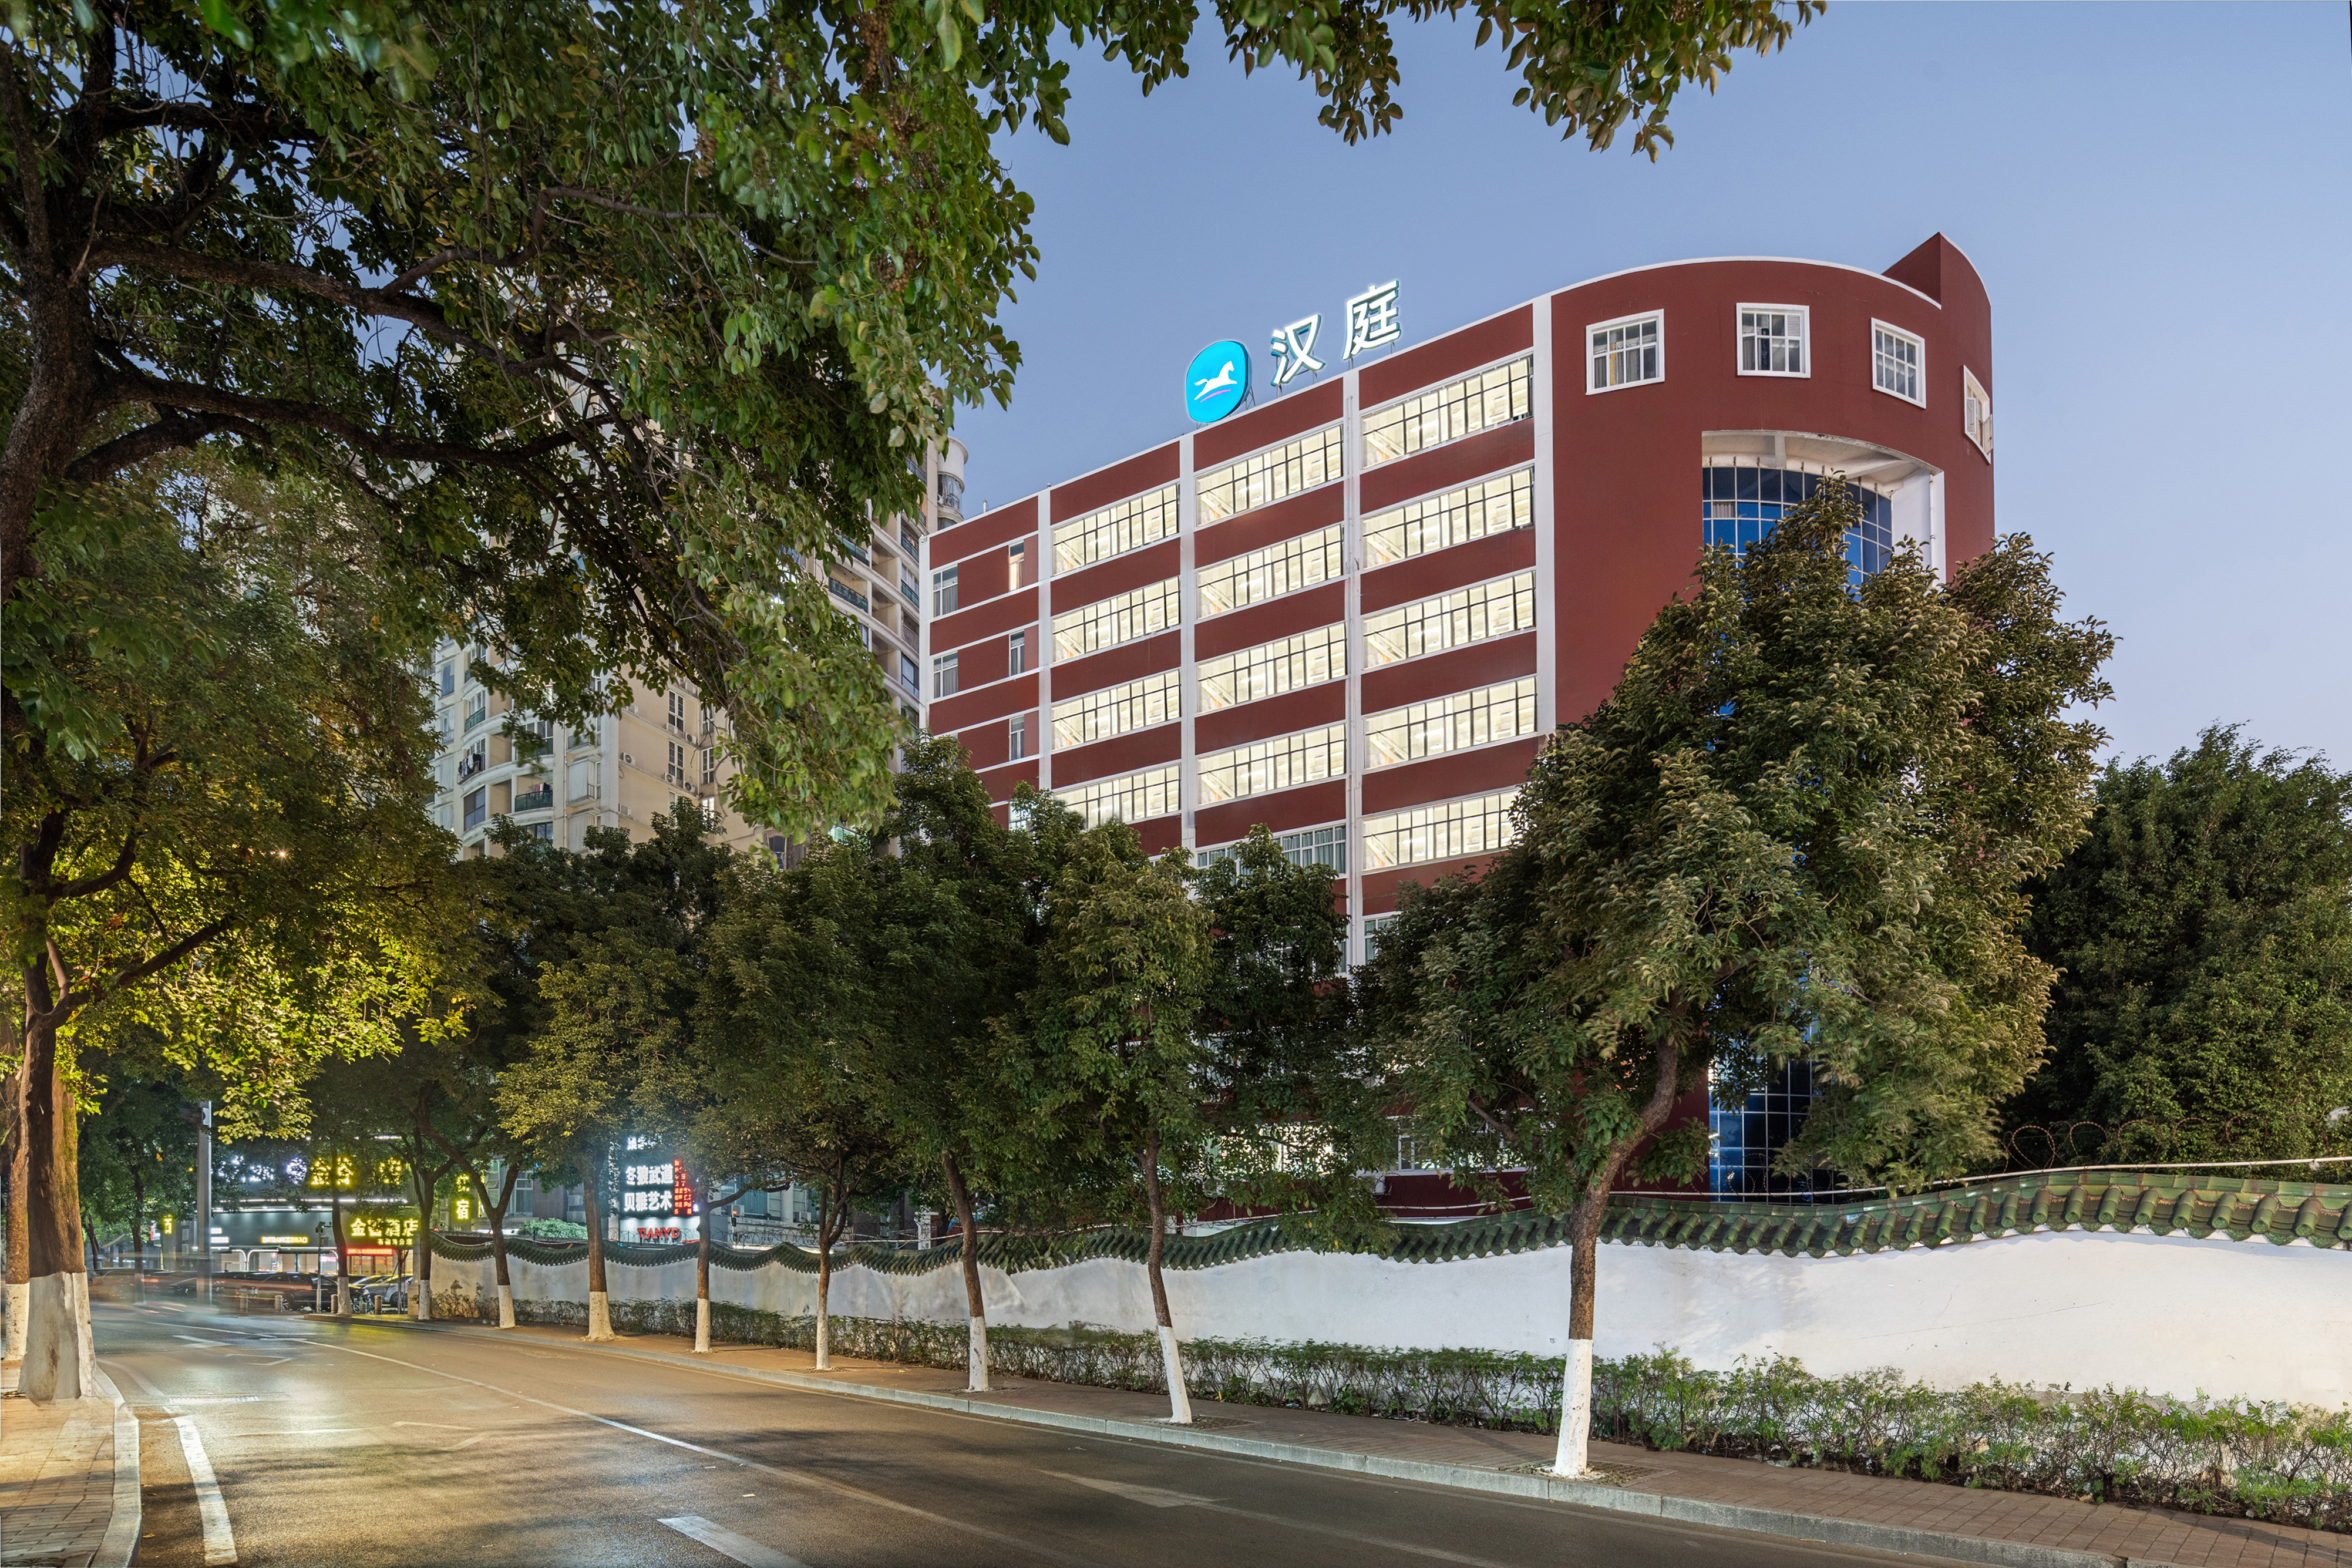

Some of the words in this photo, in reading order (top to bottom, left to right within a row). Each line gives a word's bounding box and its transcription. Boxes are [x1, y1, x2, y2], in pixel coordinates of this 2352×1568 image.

[1271, 280, 1401, 387] 汉庭
[625, 1164, 674, 1185] 冬狼武道
[624, 1190, 672, 1212] 贝雅艺术
